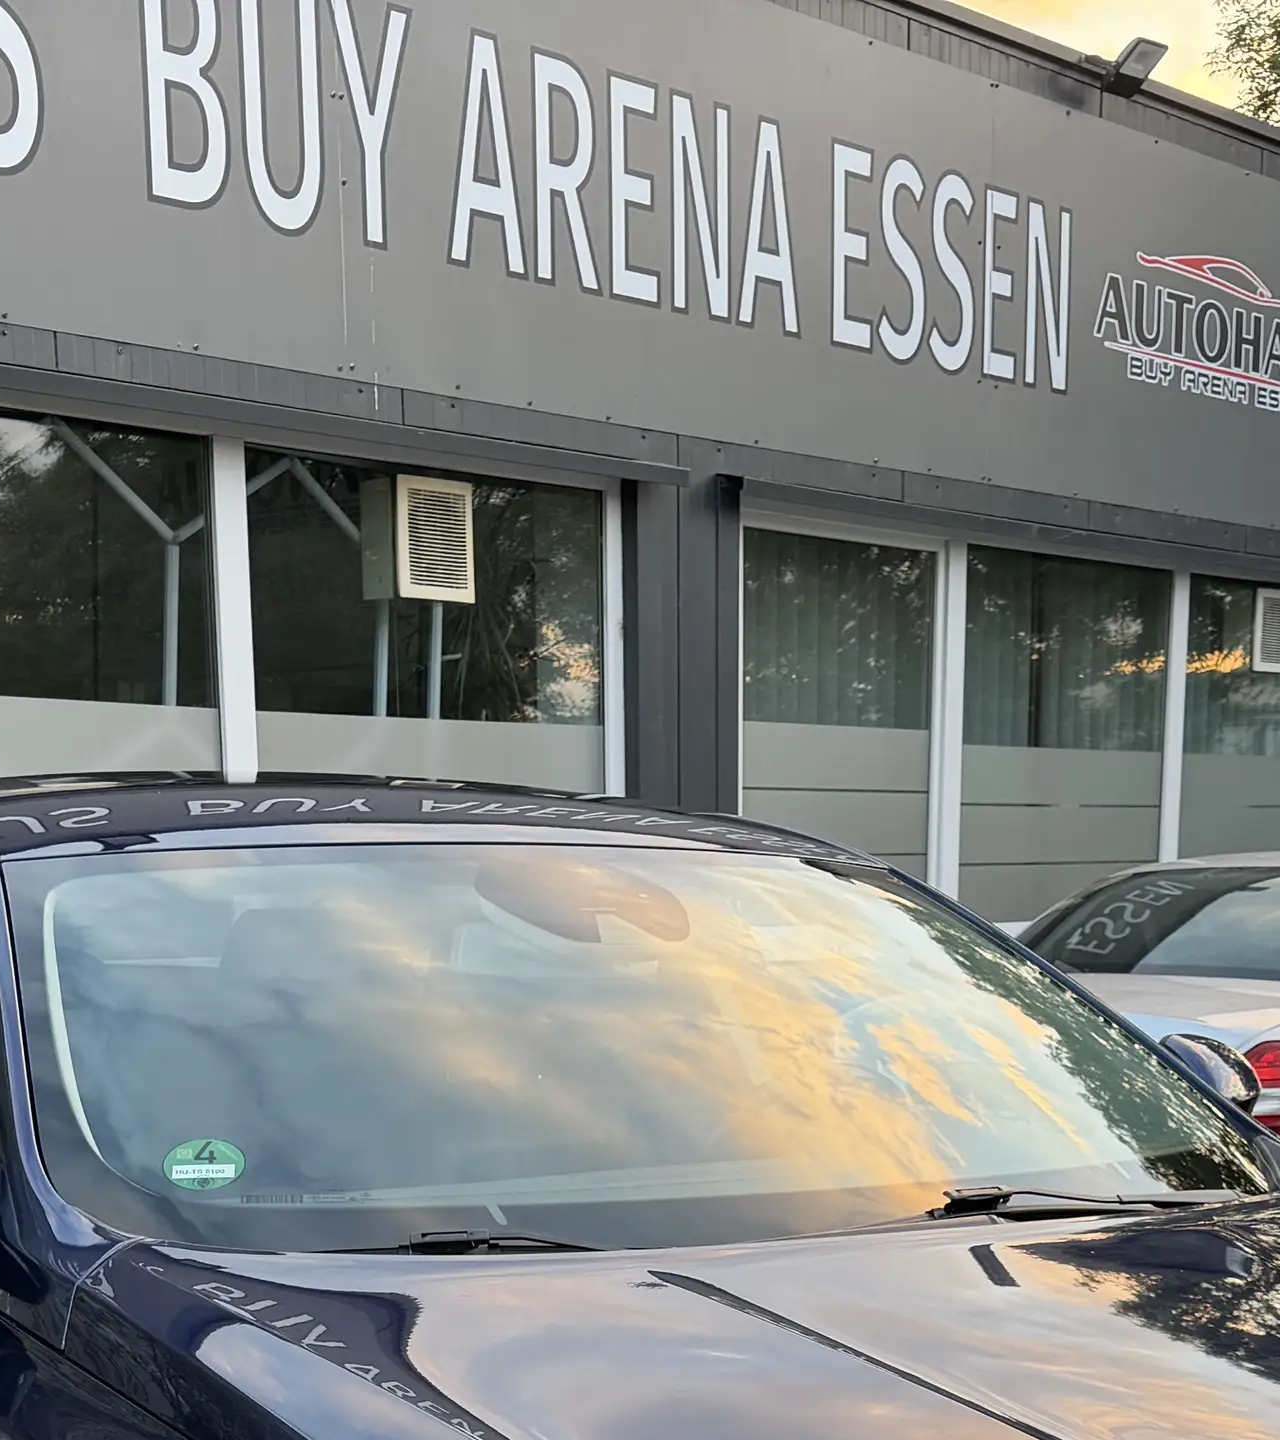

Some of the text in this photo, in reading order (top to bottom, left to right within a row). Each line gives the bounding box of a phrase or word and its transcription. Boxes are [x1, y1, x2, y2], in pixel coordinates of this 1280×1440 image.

[145, 0, 412, 248] BUY
[448, 30, 800, 336] ARENA
[828, 136, 1075, 394] ESSEN
[1127, 353, 1174, 386] BUY
[1180, 368, 1249, 404] ARENA
[194, 1141, 217, 1164] 4
